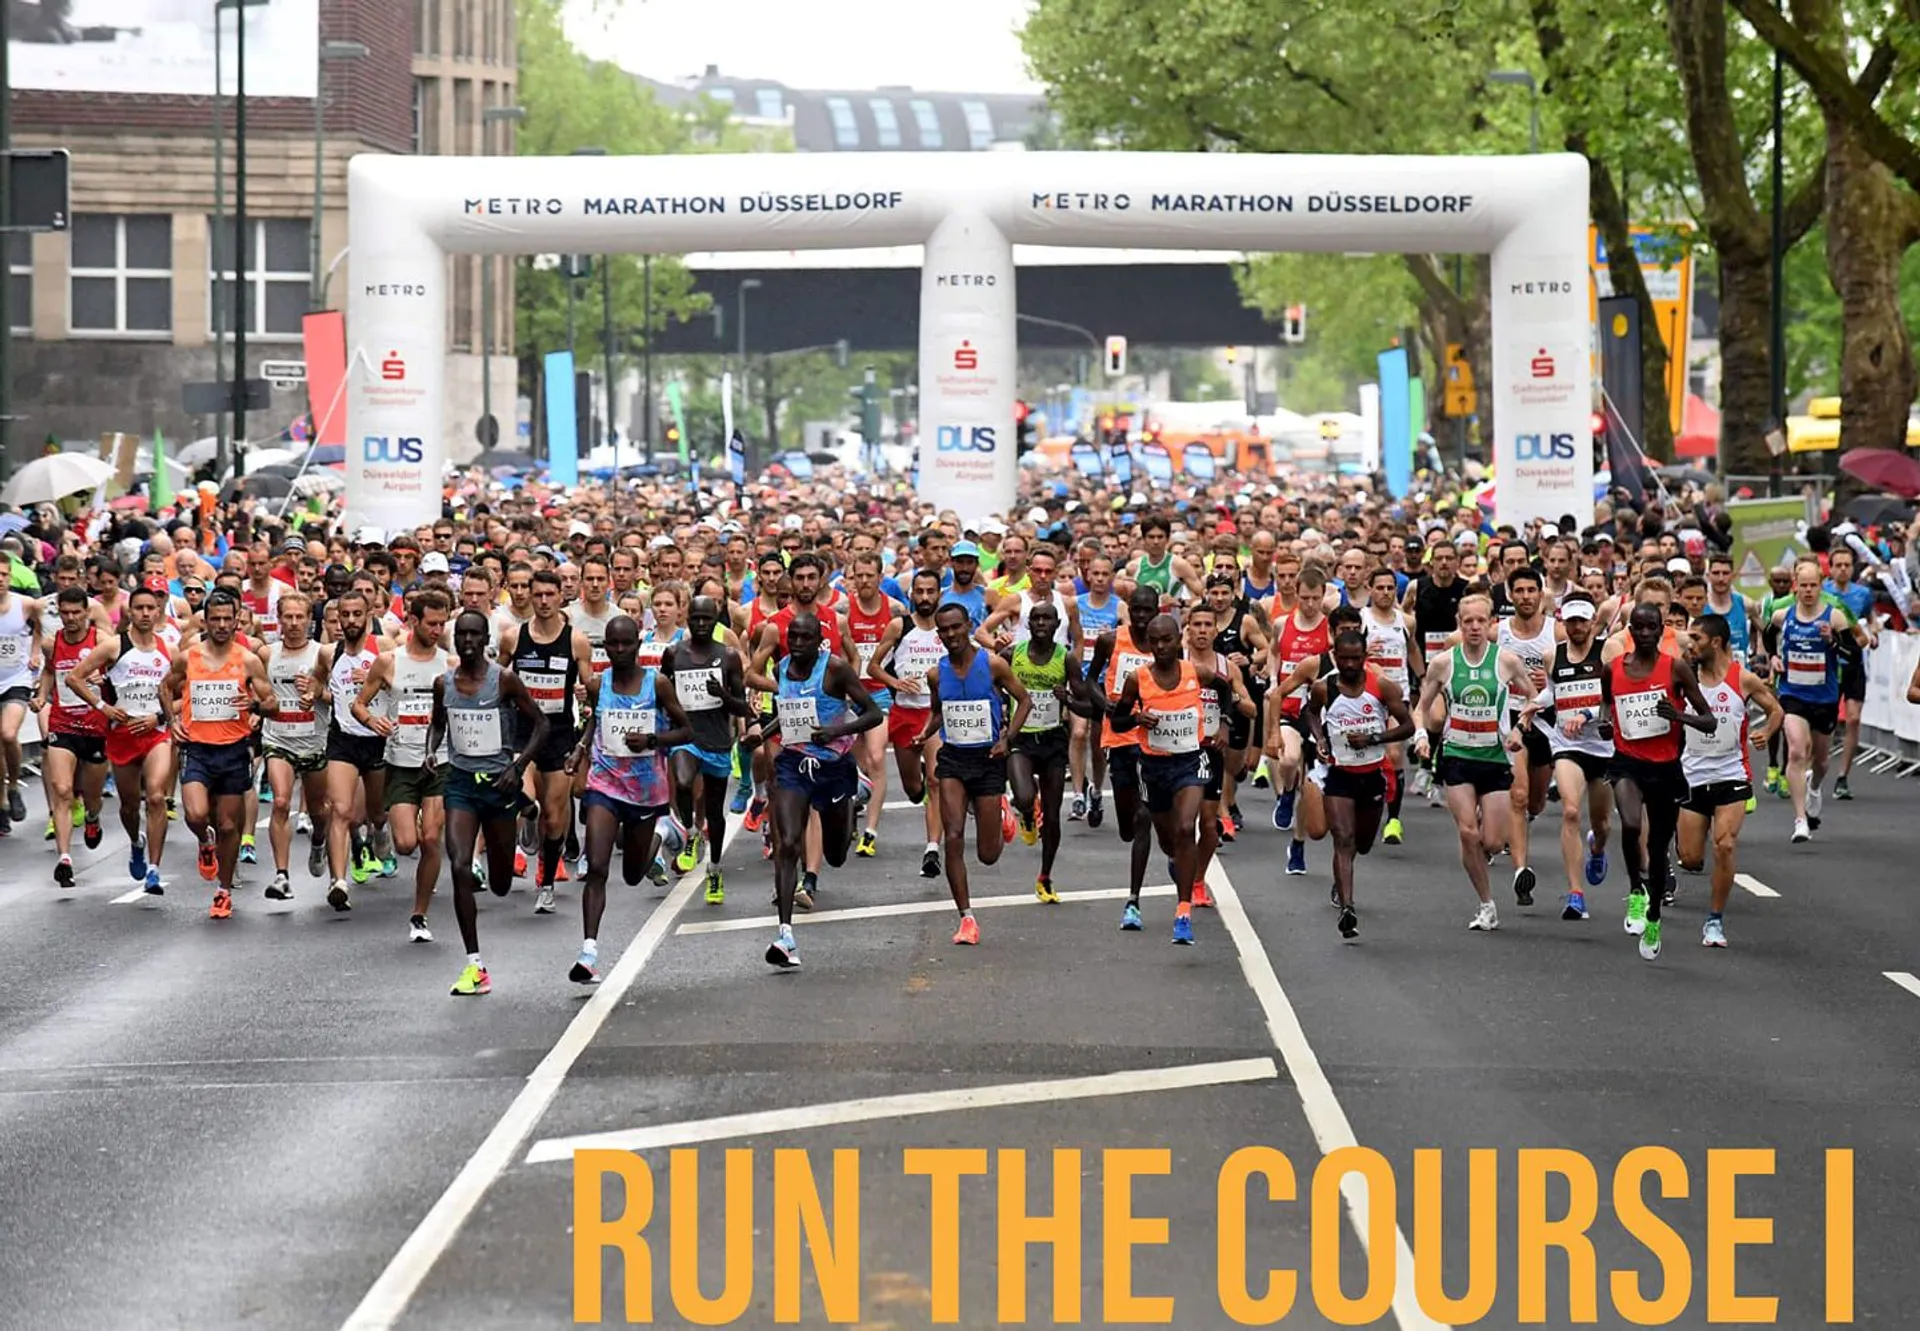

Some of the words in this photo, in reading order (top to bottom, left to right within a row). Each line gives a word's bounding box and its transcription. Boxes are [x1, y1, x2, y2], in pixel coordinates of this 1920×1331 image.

[465, 198, 562, 214] METRO
[584, 196, 725, 214] MARATHON
[740, 191, 903, 214] DÜSSELDORF
[1033, 192, 1131, 209] METRO
[1151, 194, 1293, 212] MARATHON
[1308, 191, 1474, 213] DÜSSELDORF
[937, 275, 996, 286] METRO
[365, 285, 425, 297] METRO
[1511, 282, 1571, 294] METRO
[937, 426, 995, 453] DUS
[364, 436, 422, 463] DUS
[1515, 434, 1575, 460] DUS
[362, 469, 422, 480] Düsseldorf
[382, 481, 422, 492] Airport
[911, 657, 938, 665] METR
[525, 675, 560, 684] METRO
[197, 684, 233, 692] METRO
[684, 684, 707, 693] PAC
[1560, 683, 1594, 692] METRO
[1621, 693, 1658, 705] METRO
[1032, 703, 1051, 712] ACE
[1457, 708, 1491, 716] METRO
[453, 713, 492, 722] METRO
[608, 711, 648, 720] METRO
[947, 718, 987, 728] DEREJE
[1153, 727, 1194, 737] DANIEL
